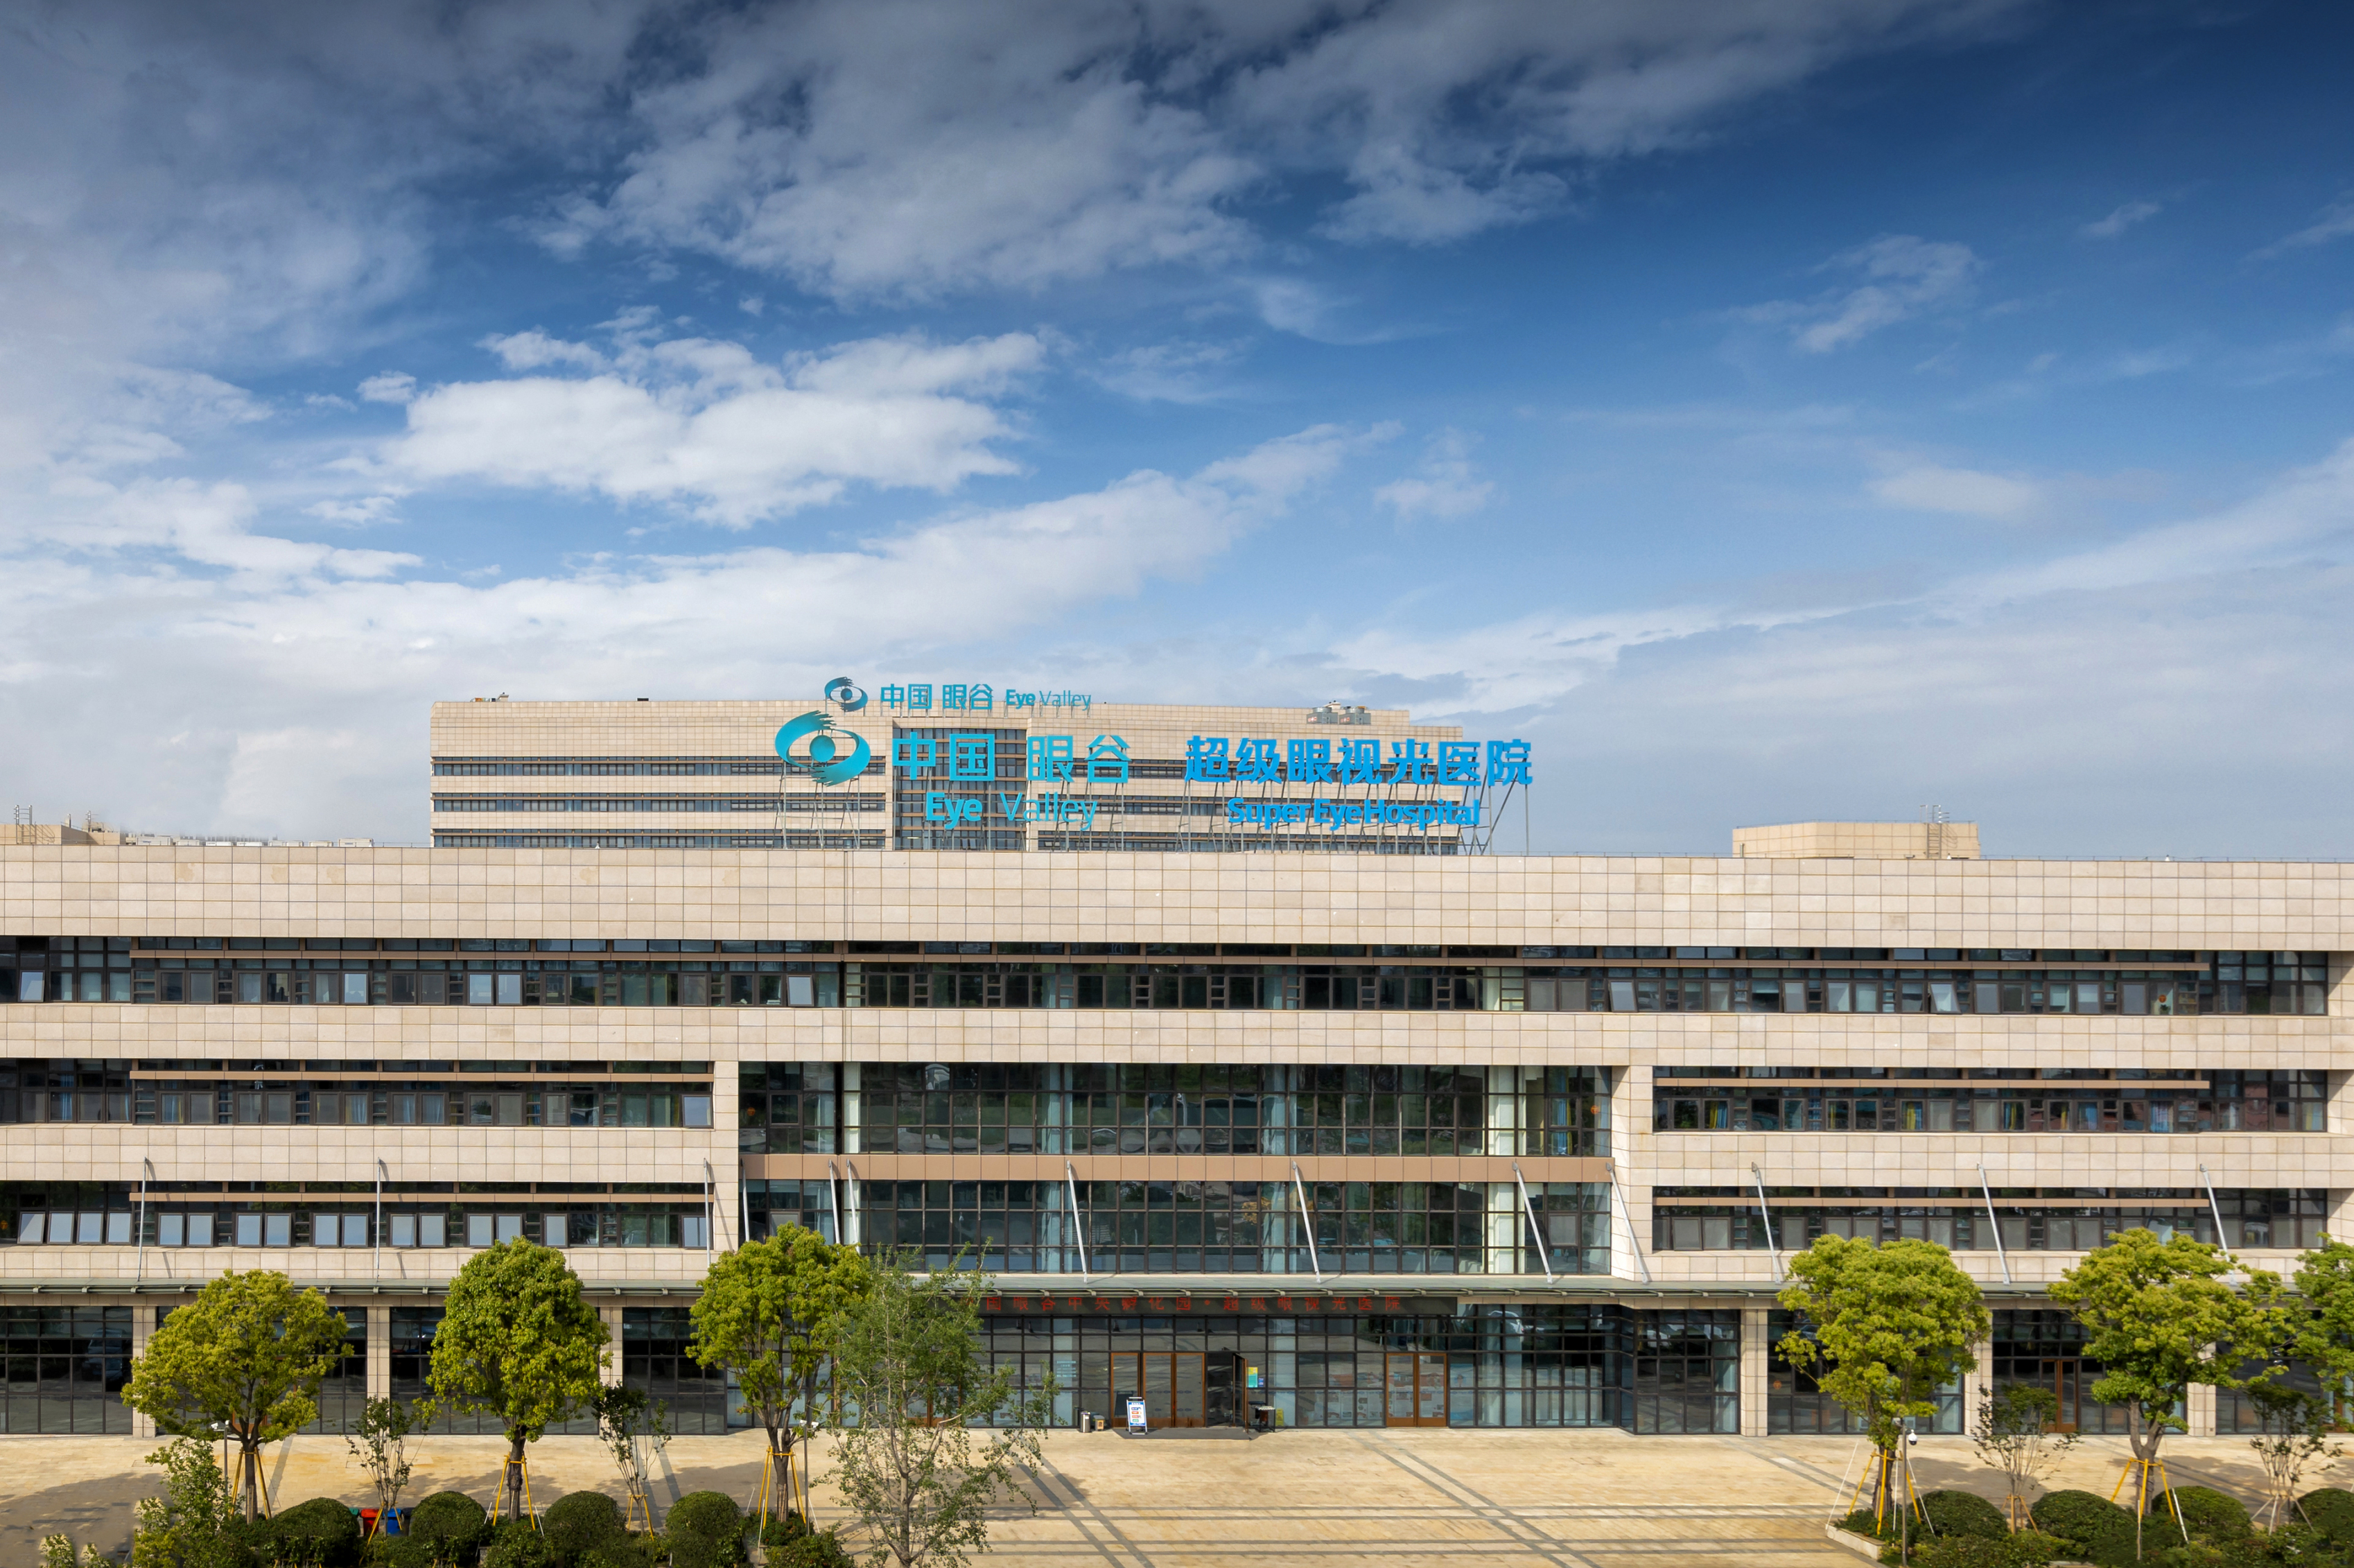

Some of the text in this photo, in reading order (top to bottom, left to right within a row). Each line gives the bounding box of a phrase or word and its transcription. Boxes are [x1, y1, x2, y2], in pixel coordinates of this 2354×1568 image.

[881, 684, 993, 709] 中国 眼谷
[1006, 690, 1090, 711] Eye Valley
[892, 731, 1131, 783] 中国 眼谷
[1184, 735, 1533, 787] 超级眼视光医院
[926, 792, 1098, 830] Eye Valley
[1227, 798, 1311, 830] Super
